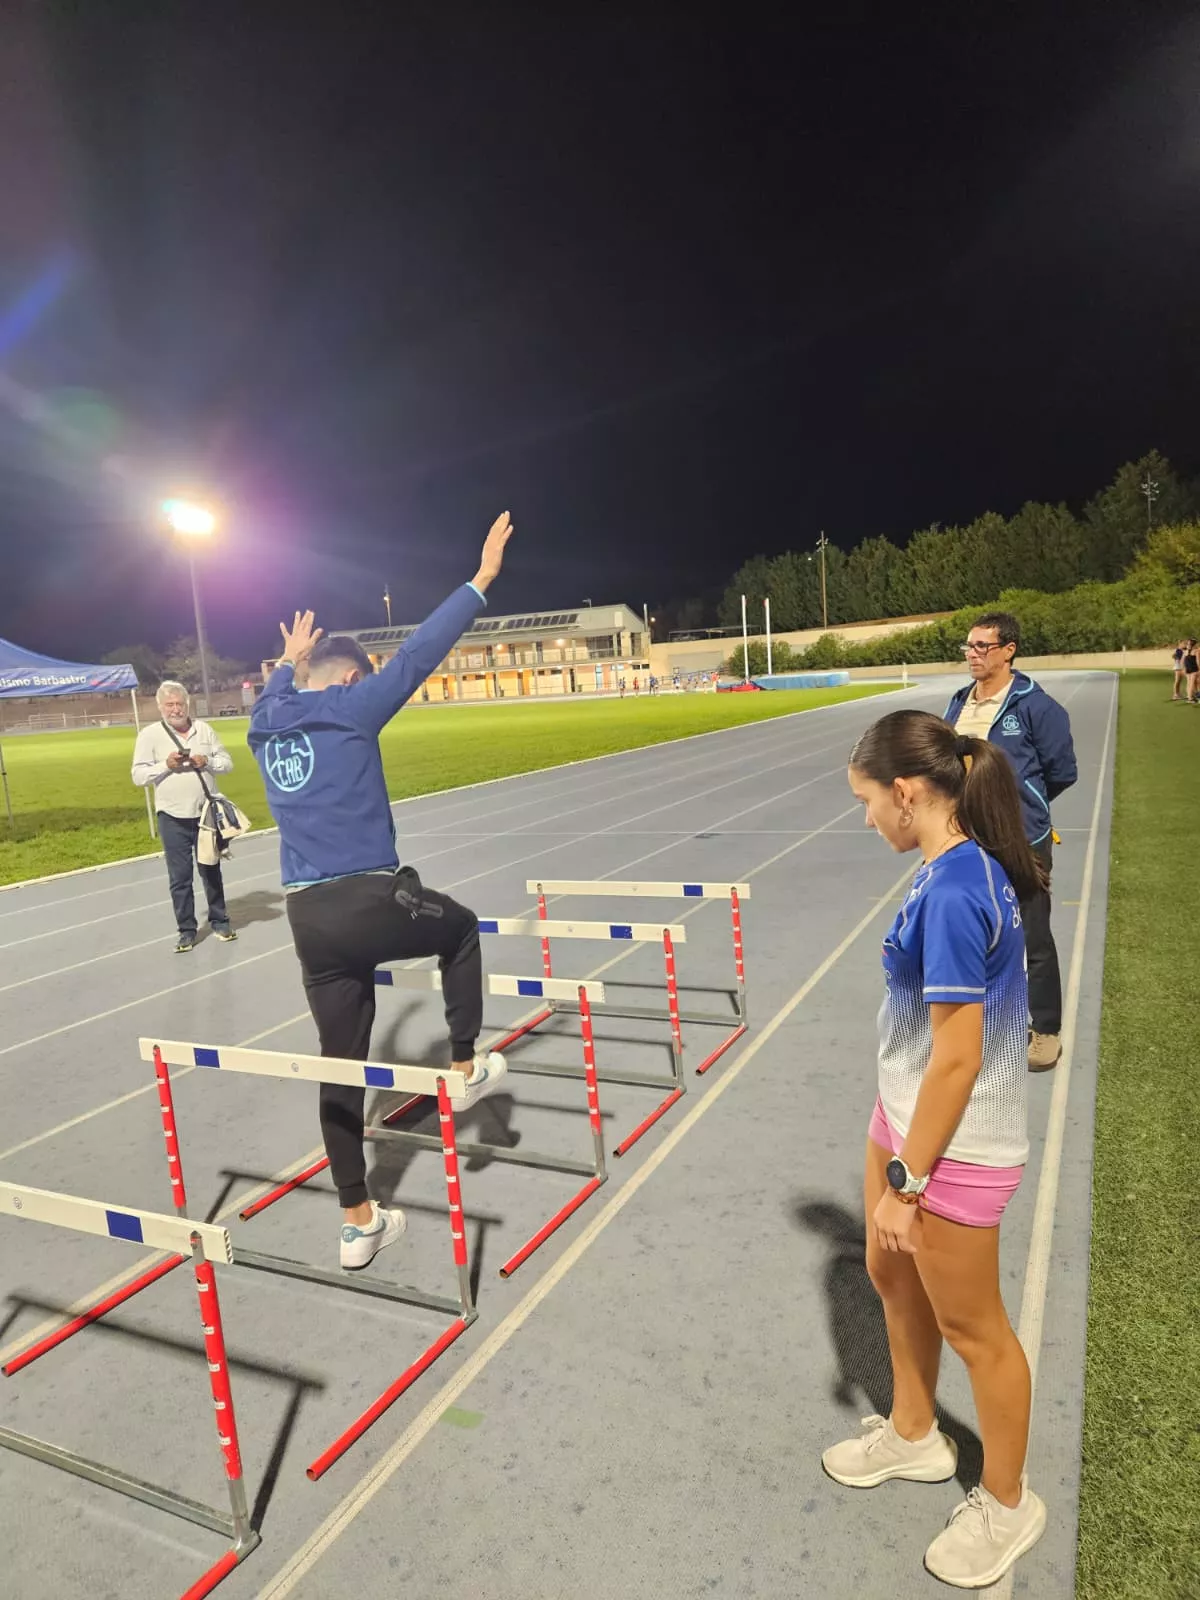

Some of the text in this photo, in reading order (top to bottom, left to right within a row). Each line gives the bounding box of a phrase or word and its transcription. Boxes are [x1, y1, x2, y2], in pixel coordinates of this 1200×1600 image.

[0, 678, 30, 688] ismo
[33, 674, 87, 686] Barbastro
[277, 755, 304, 786] CAB
